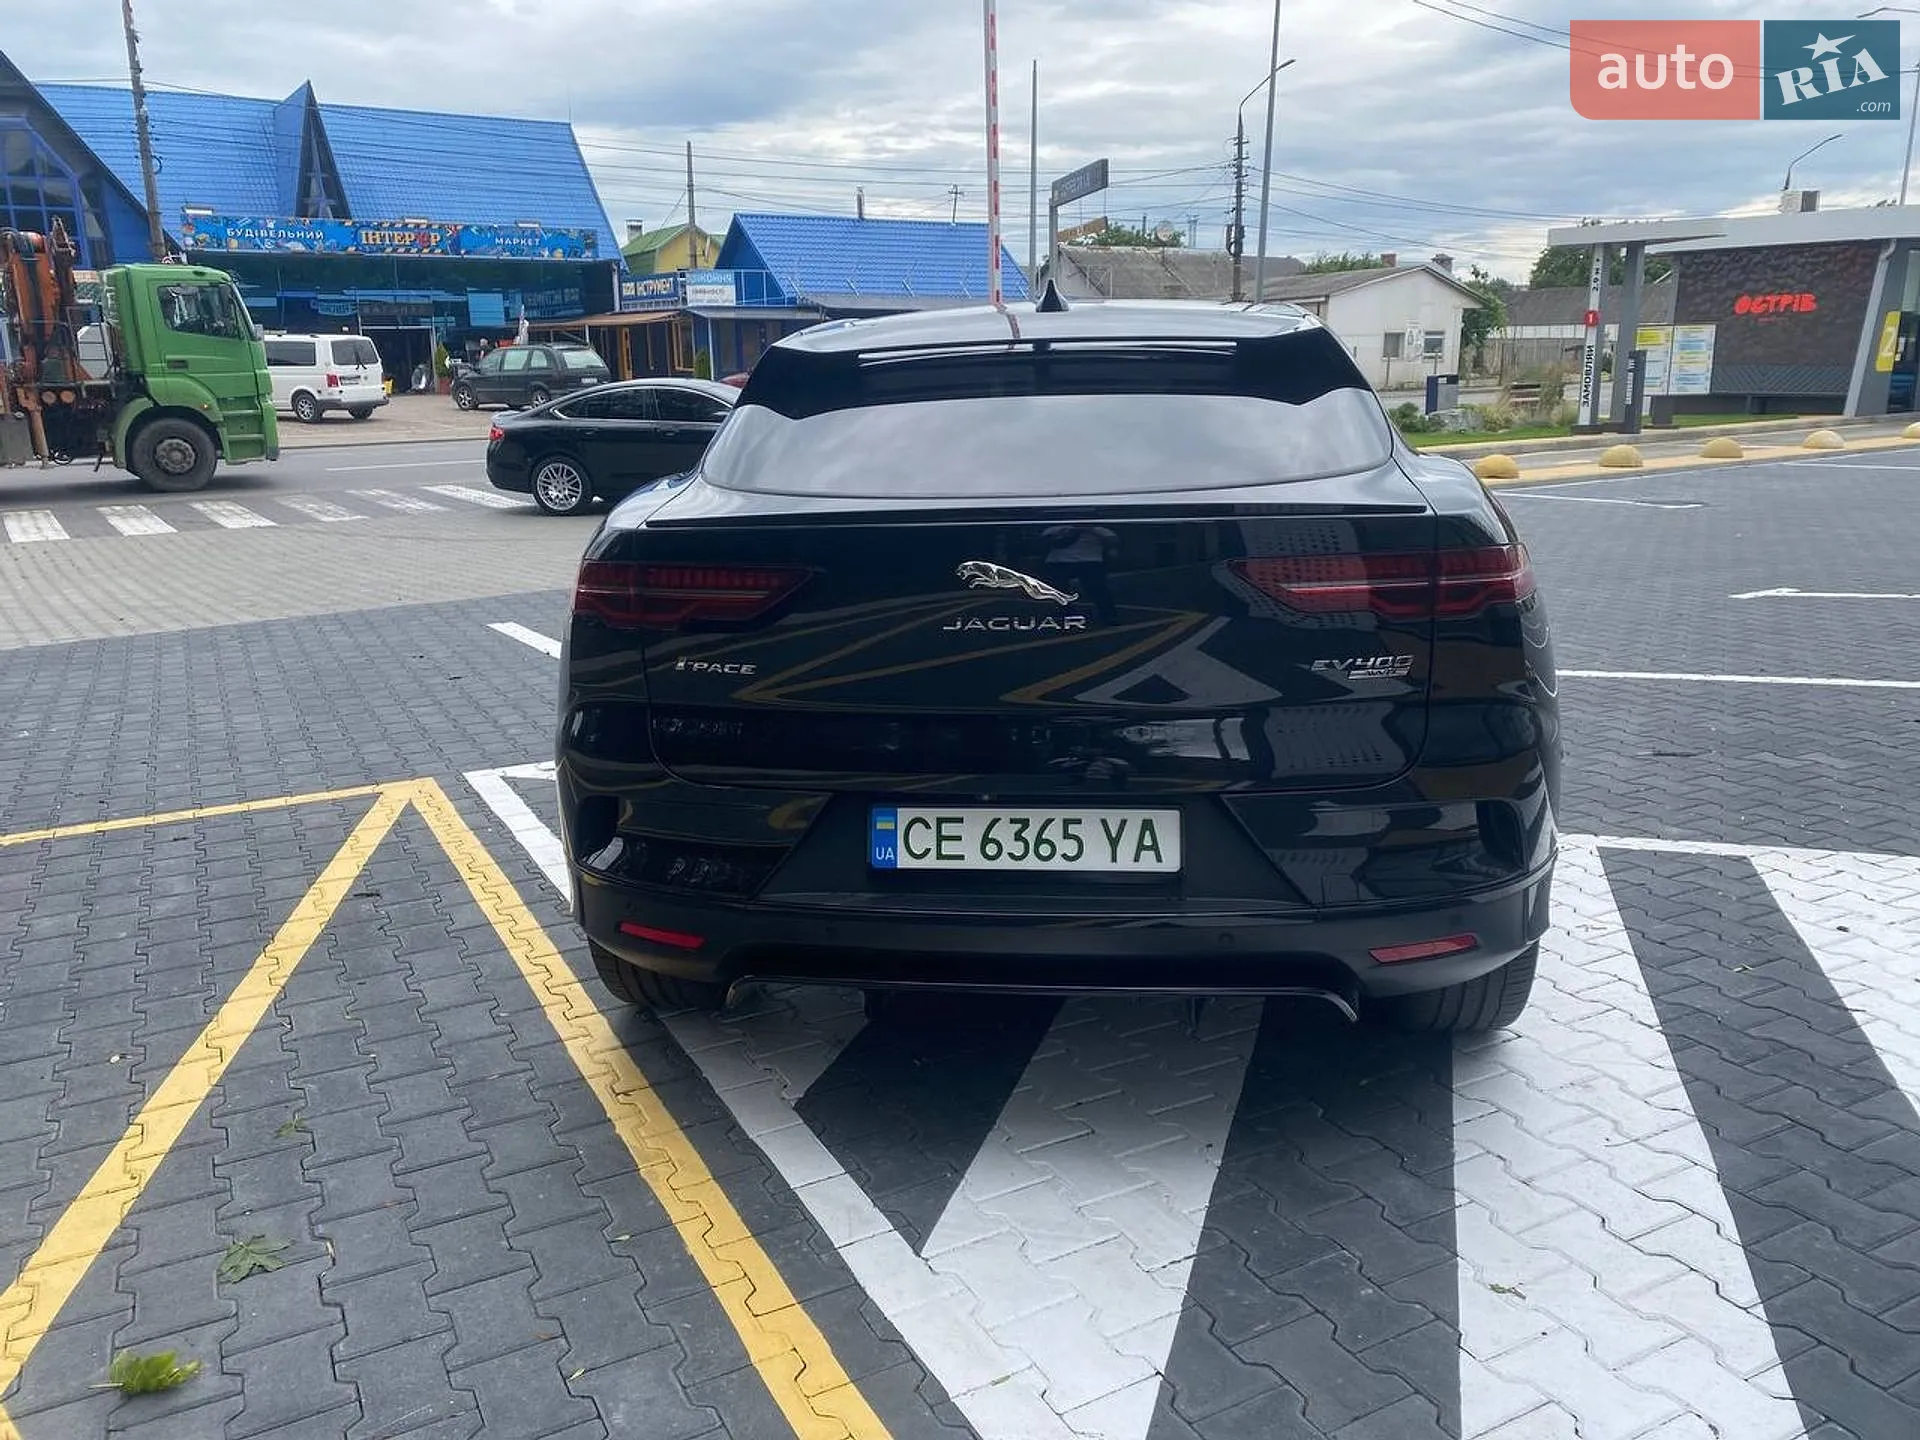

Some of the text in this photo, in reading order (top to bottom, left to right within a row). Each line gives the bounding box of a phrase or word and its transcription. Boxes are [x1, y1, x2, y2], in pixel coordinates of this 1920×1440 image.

[226, 227, 324, 240] БУДІВЕЛЬНИЙ
[494, 236, 540, 247] МАРКЕТ
[1734, 293, 1817, 315] ОСТРІВ
[943, 615, 1087, 632] JAGUAR
[902, 816, 1164, 864] CE 6365 YA
[875, 847, 896, 861] UA
